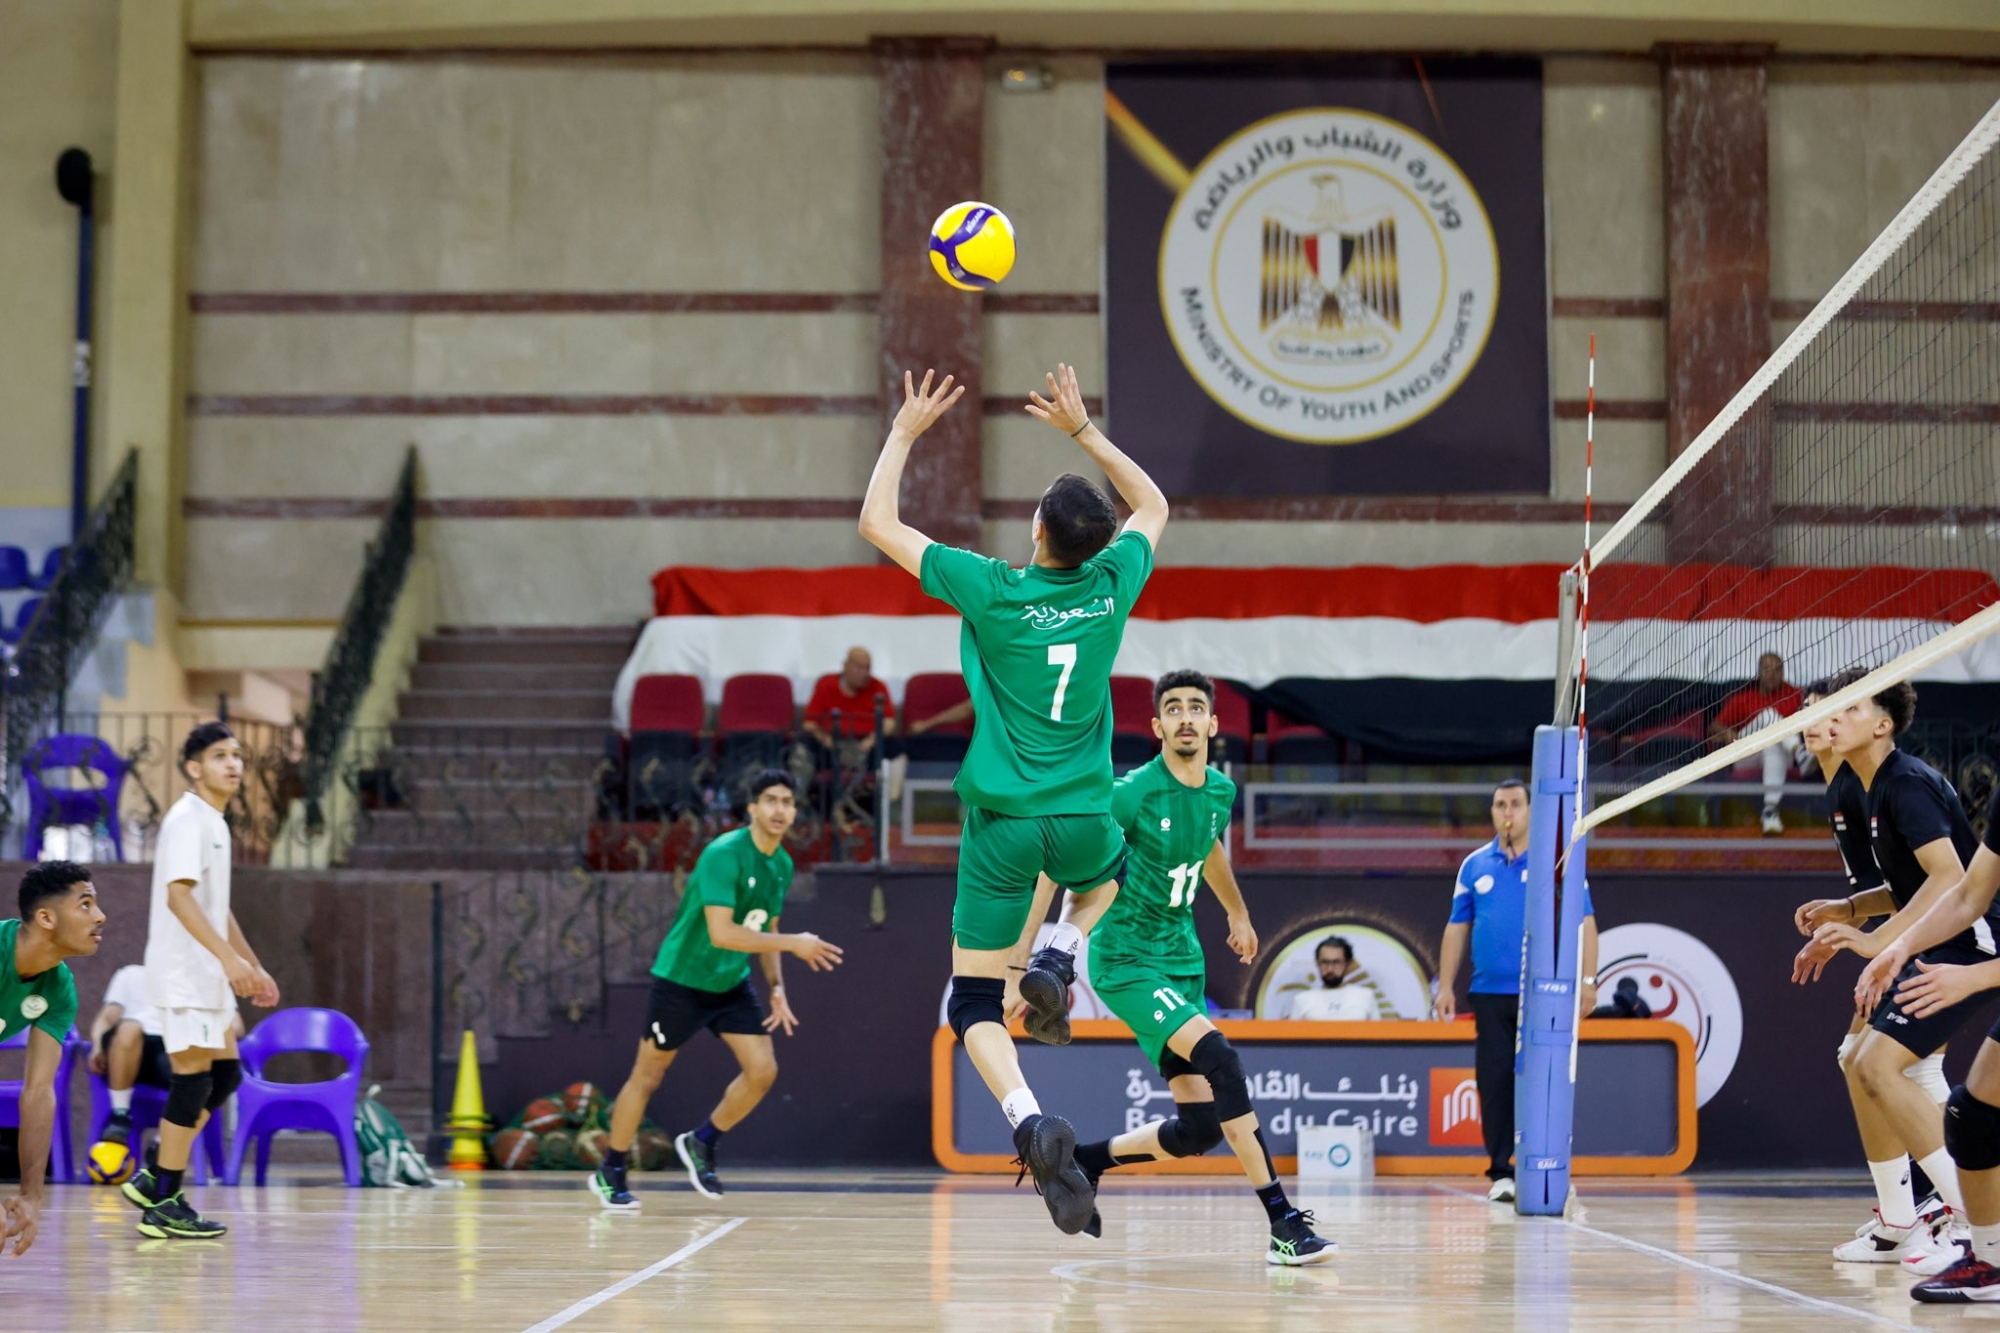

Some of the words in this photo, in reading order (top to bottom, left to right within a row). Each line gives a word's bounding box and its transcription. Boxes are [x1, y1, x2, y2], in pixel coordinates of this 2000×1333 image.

[1303, 125, 1402, 163] الشباب
[1193, 136, 1294, 231] والرياضة
[1406, 158, 1461, 230] وزارة
[1180, 286, 1255, 393] MINISTRY
[1258, 385, 1292, 412] OF
[1301, 398, 1377, 421] YOUTH
[1384, 373, 1432, 412] AND
[1429, 290, 1474, 383] SPORTS
[1048, 643, 1077, 722] 7
[1167, 860, 1204, 907] 11
[1153, 987, 1186, 1011] 11
[1126, 1069, 1300, 1107] القارة
[1270, 1107, 1314, 1135] du
[1327, 1108, 1418, 1136] Caire
